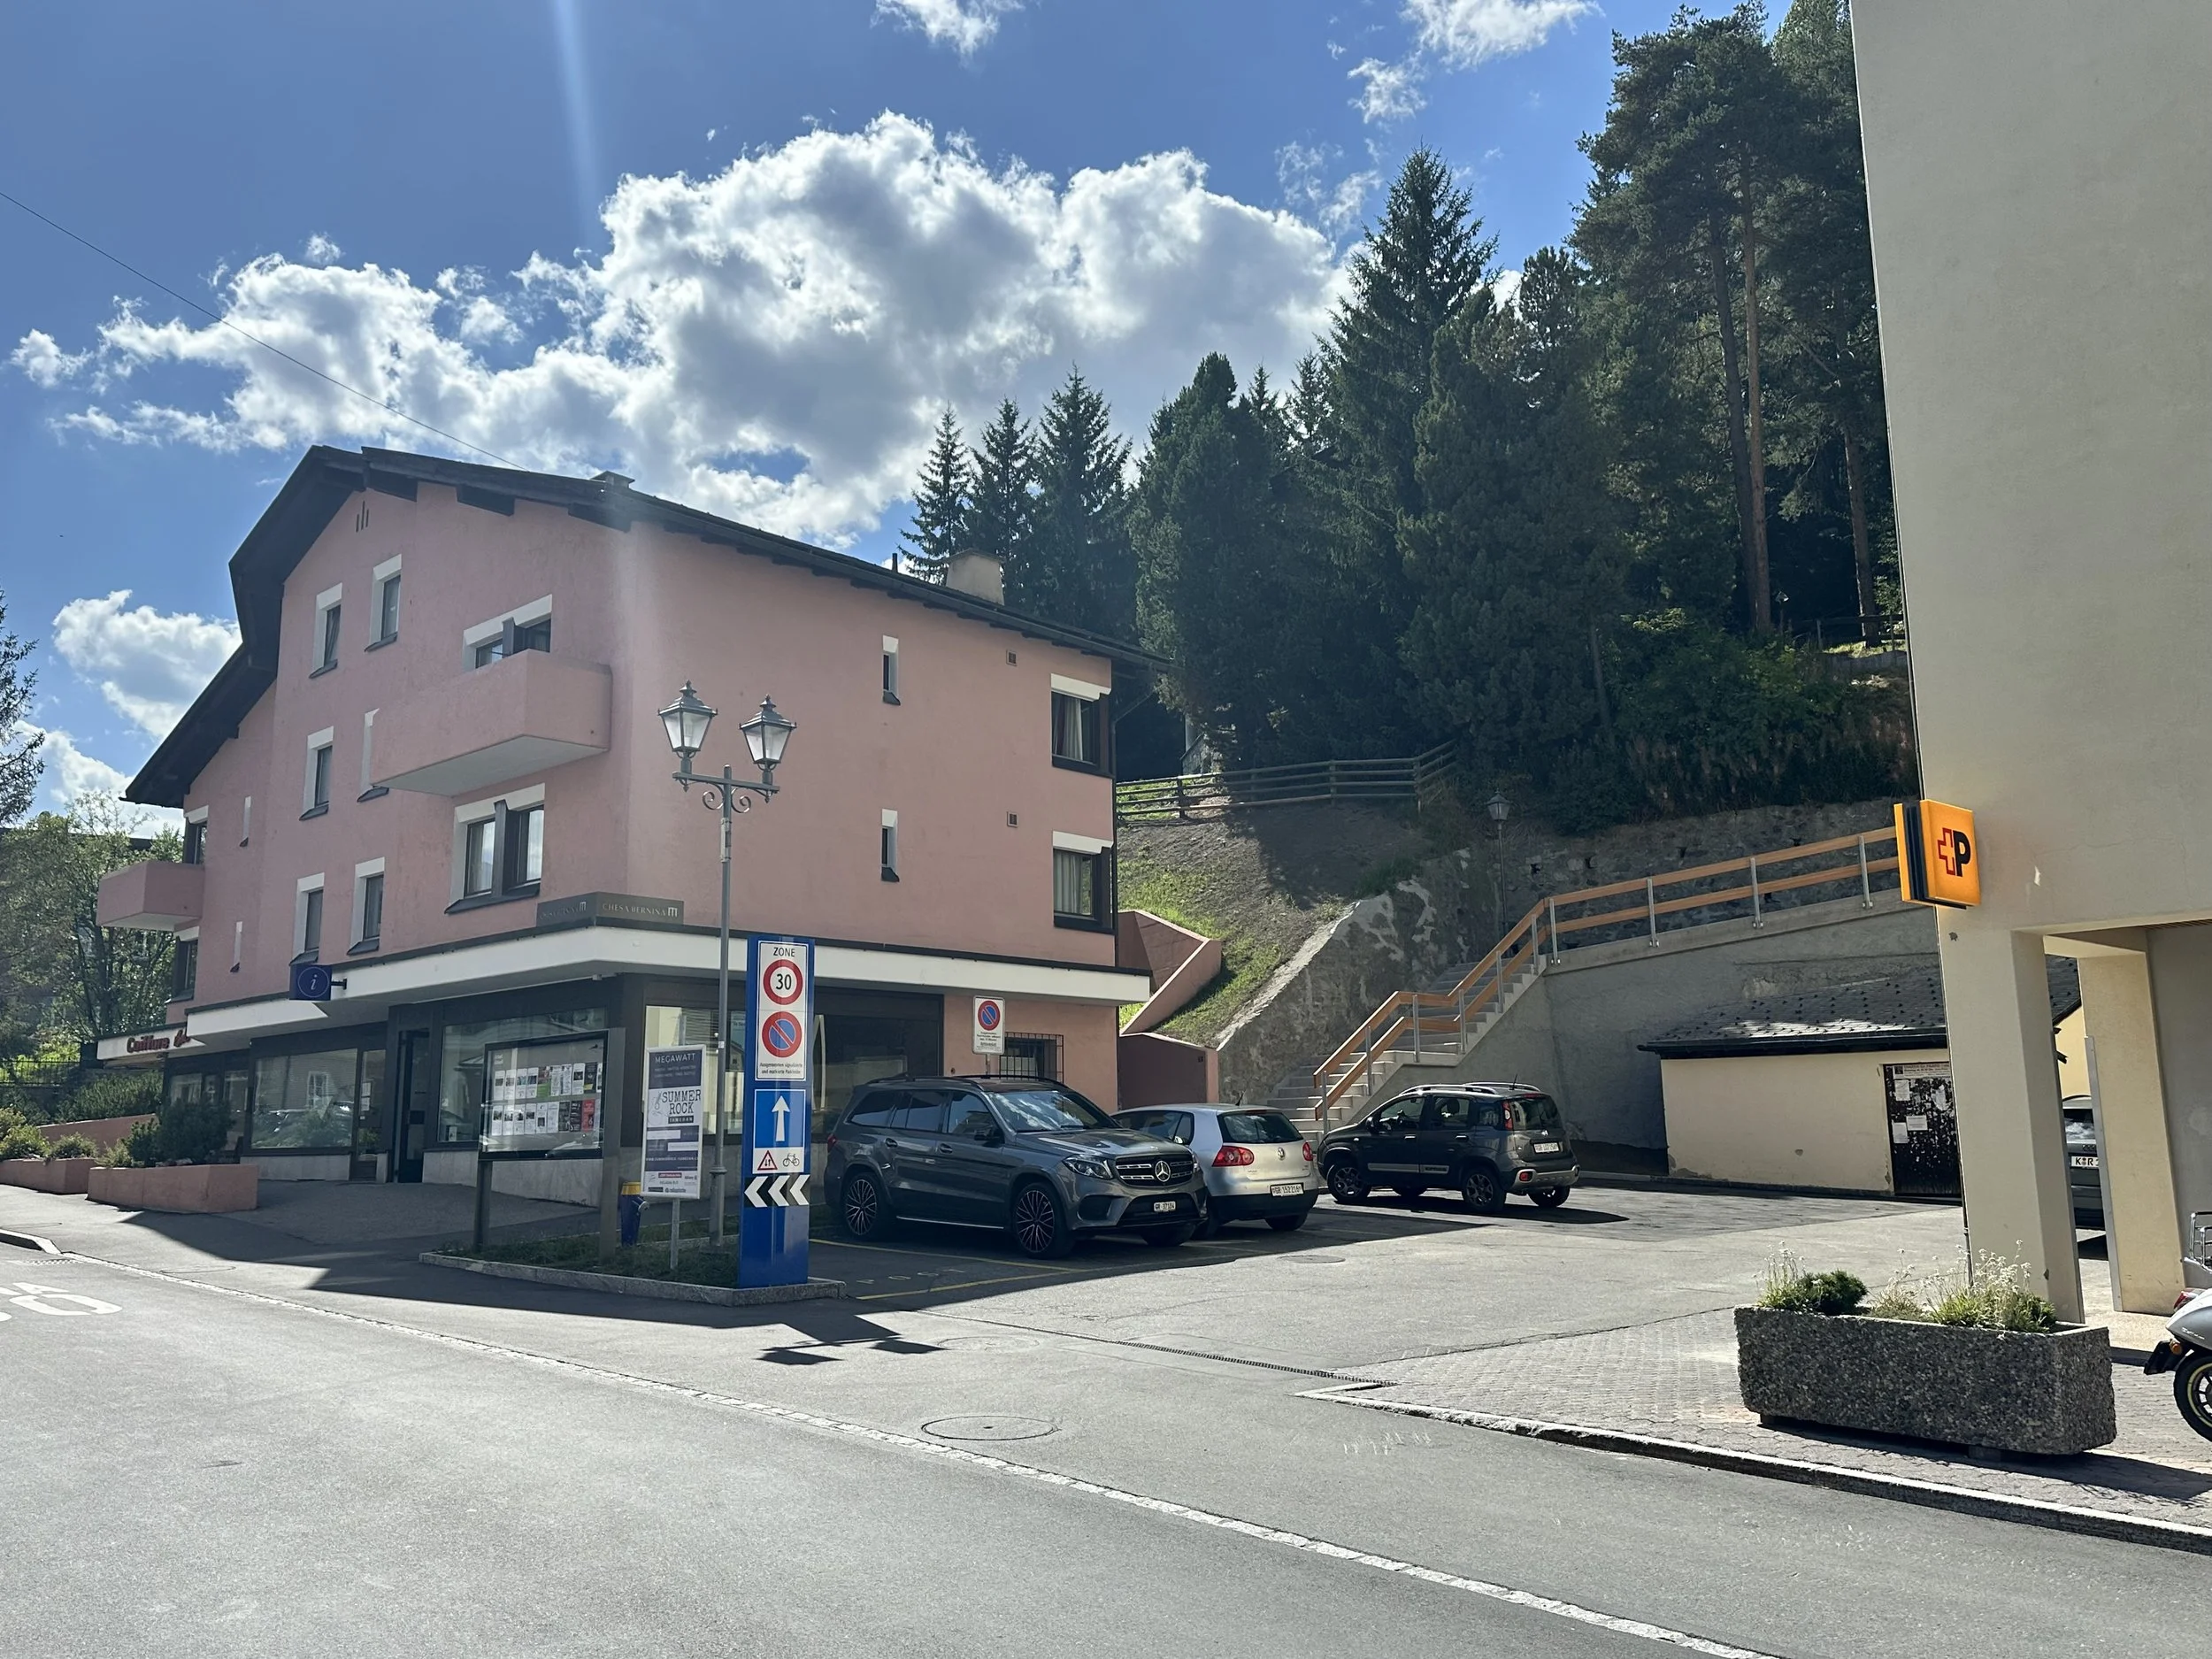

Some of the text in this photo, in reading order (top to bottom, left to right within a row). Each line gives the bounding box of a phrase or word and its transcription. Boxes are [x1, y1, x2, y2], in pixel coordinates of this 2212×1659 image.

[1952, 829, 1971, 878] P
[603, 902, 666, 917] CHESA BERNINA
[773, 947, 795, 957] ZONE
[775, 973, 792, 990] 30
[127, 1035, 170, 1053] Coiffure
[655, 1053, 695, 1064] MEGAWATT
[662, 1089, 701, 1102] SUMMER
[669, 1102, 694, 1115] ROCK
